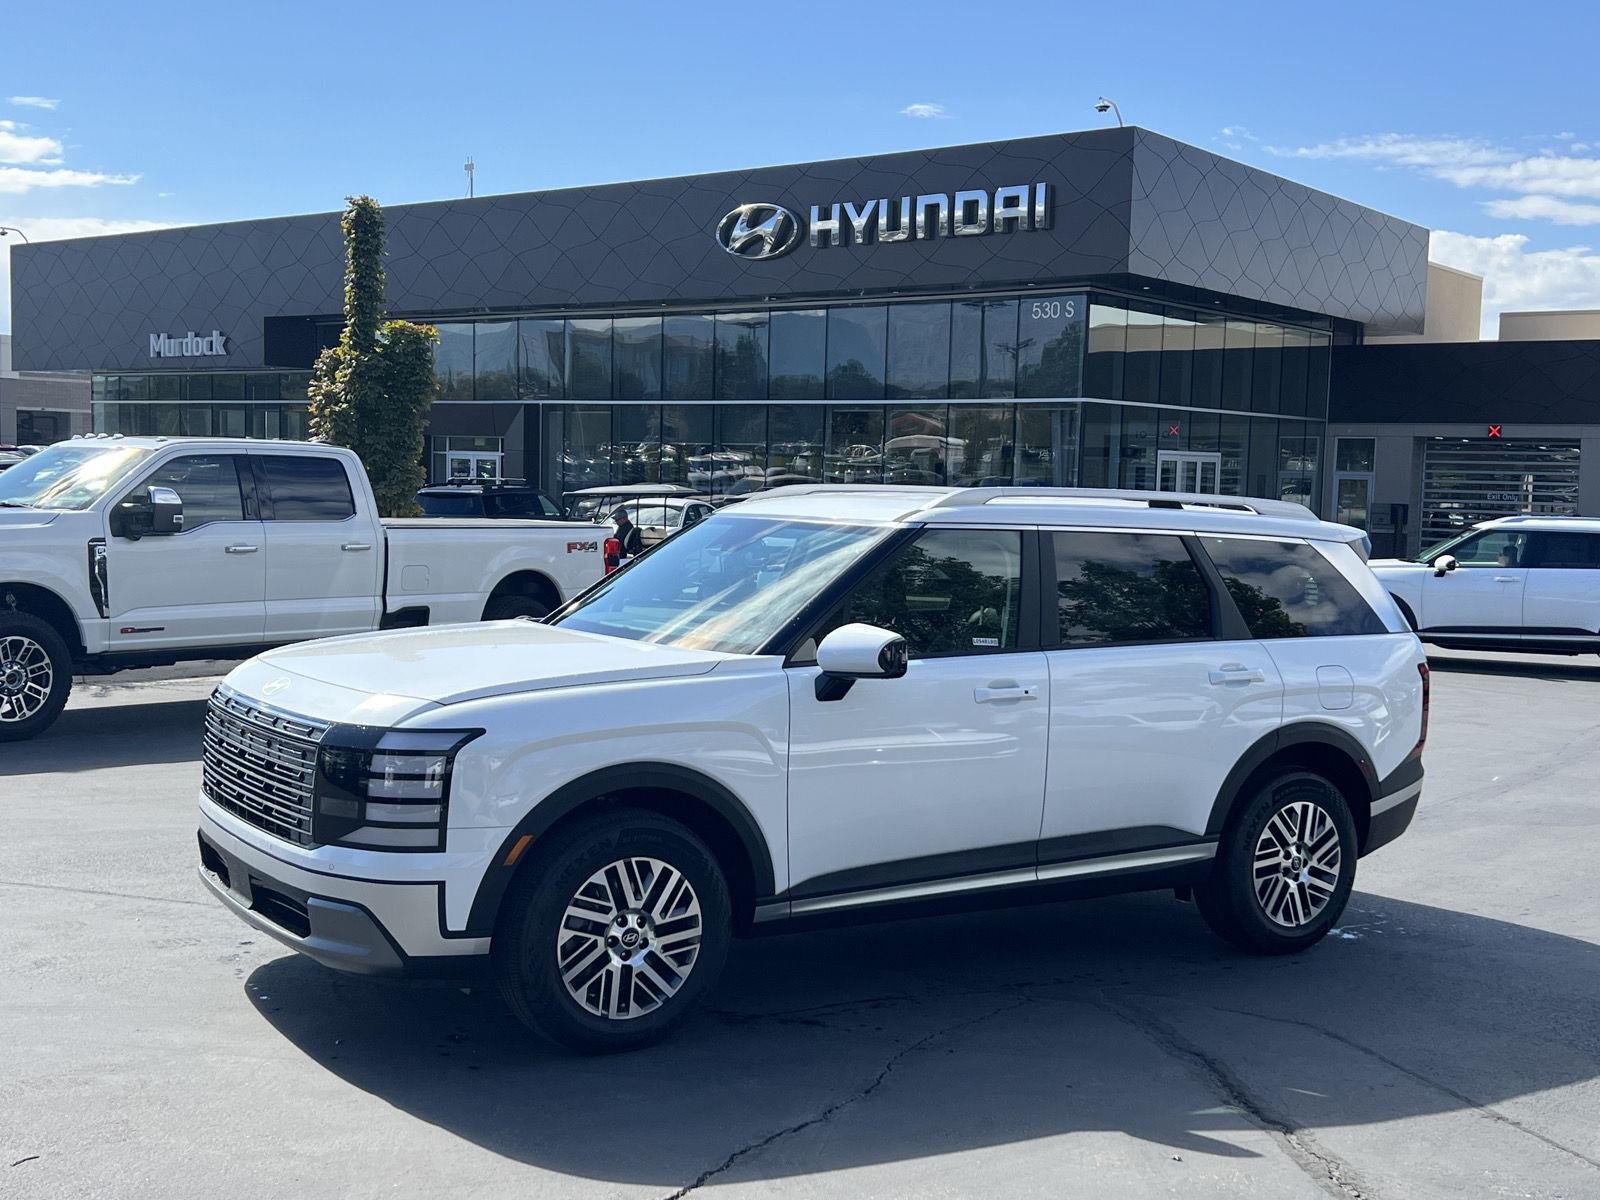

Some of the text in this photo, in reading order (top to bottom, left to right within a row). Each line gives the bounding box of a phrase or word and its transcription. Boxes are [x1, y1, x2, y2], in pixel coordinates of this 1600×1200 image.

[810, 182, 1047, 248] HYUNDAI
[1031, 301, 1075, 320] 530 S
[149, 330, 227, 357] Murdock
[1487, 492, 1519, 502] Exit Only
[567, 541, 598, 553] FX4
